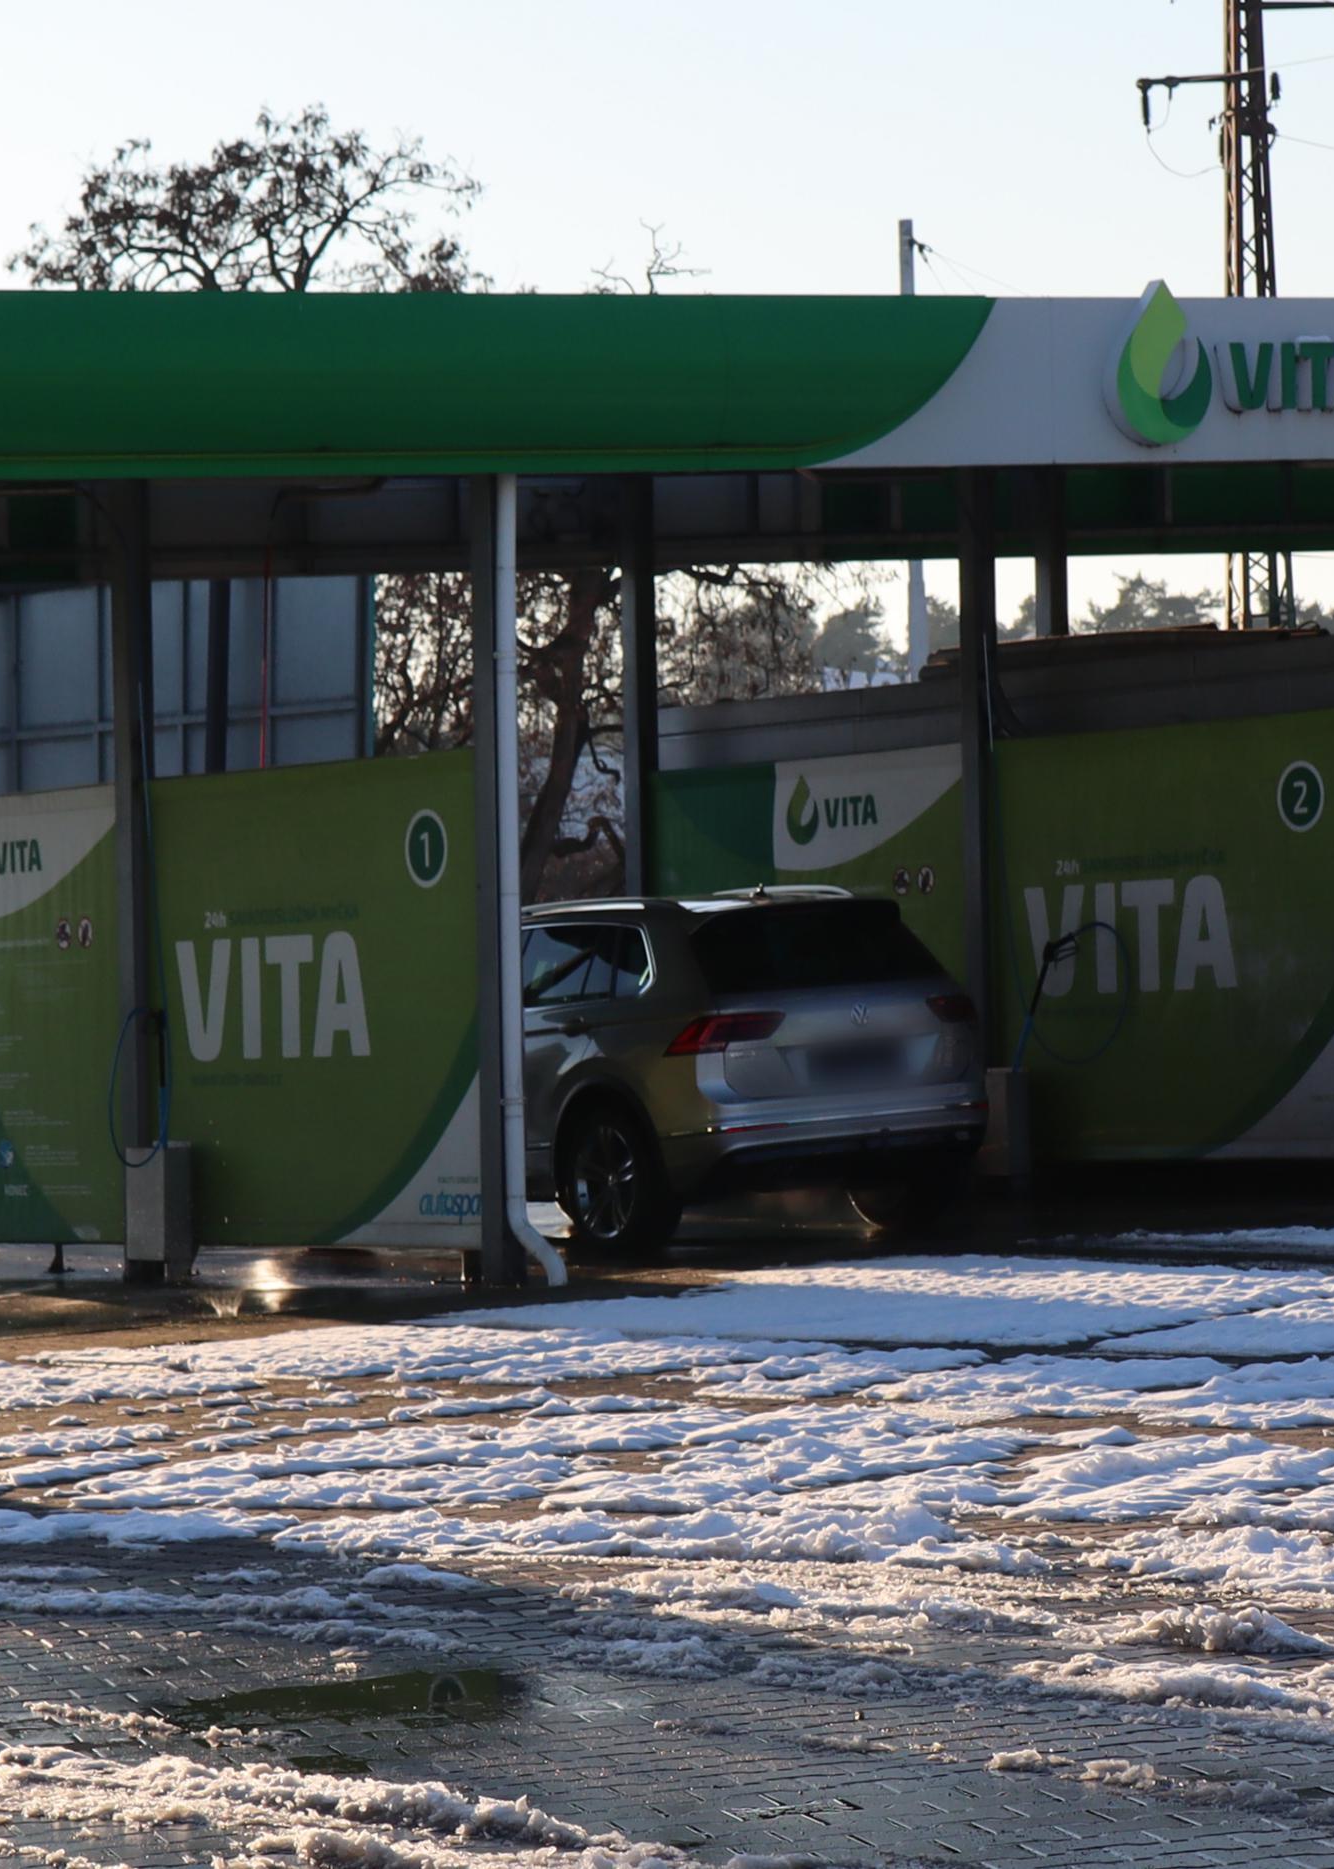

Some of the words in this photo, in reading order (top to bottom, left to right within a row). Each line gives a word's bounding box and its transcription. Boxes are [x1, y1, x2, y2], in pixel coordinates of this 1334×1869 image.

[823, 794, 878, 829] VITA
[1293, 780, 1308, 814] 2
[420, 831, 429, 868] 1
[1055, 857, 1080, 876] 24h
[203, 910, 227, 929] 24h
[1024, 874, 1238, 998] VITA
[175, 931, 371, 1062] VITA
